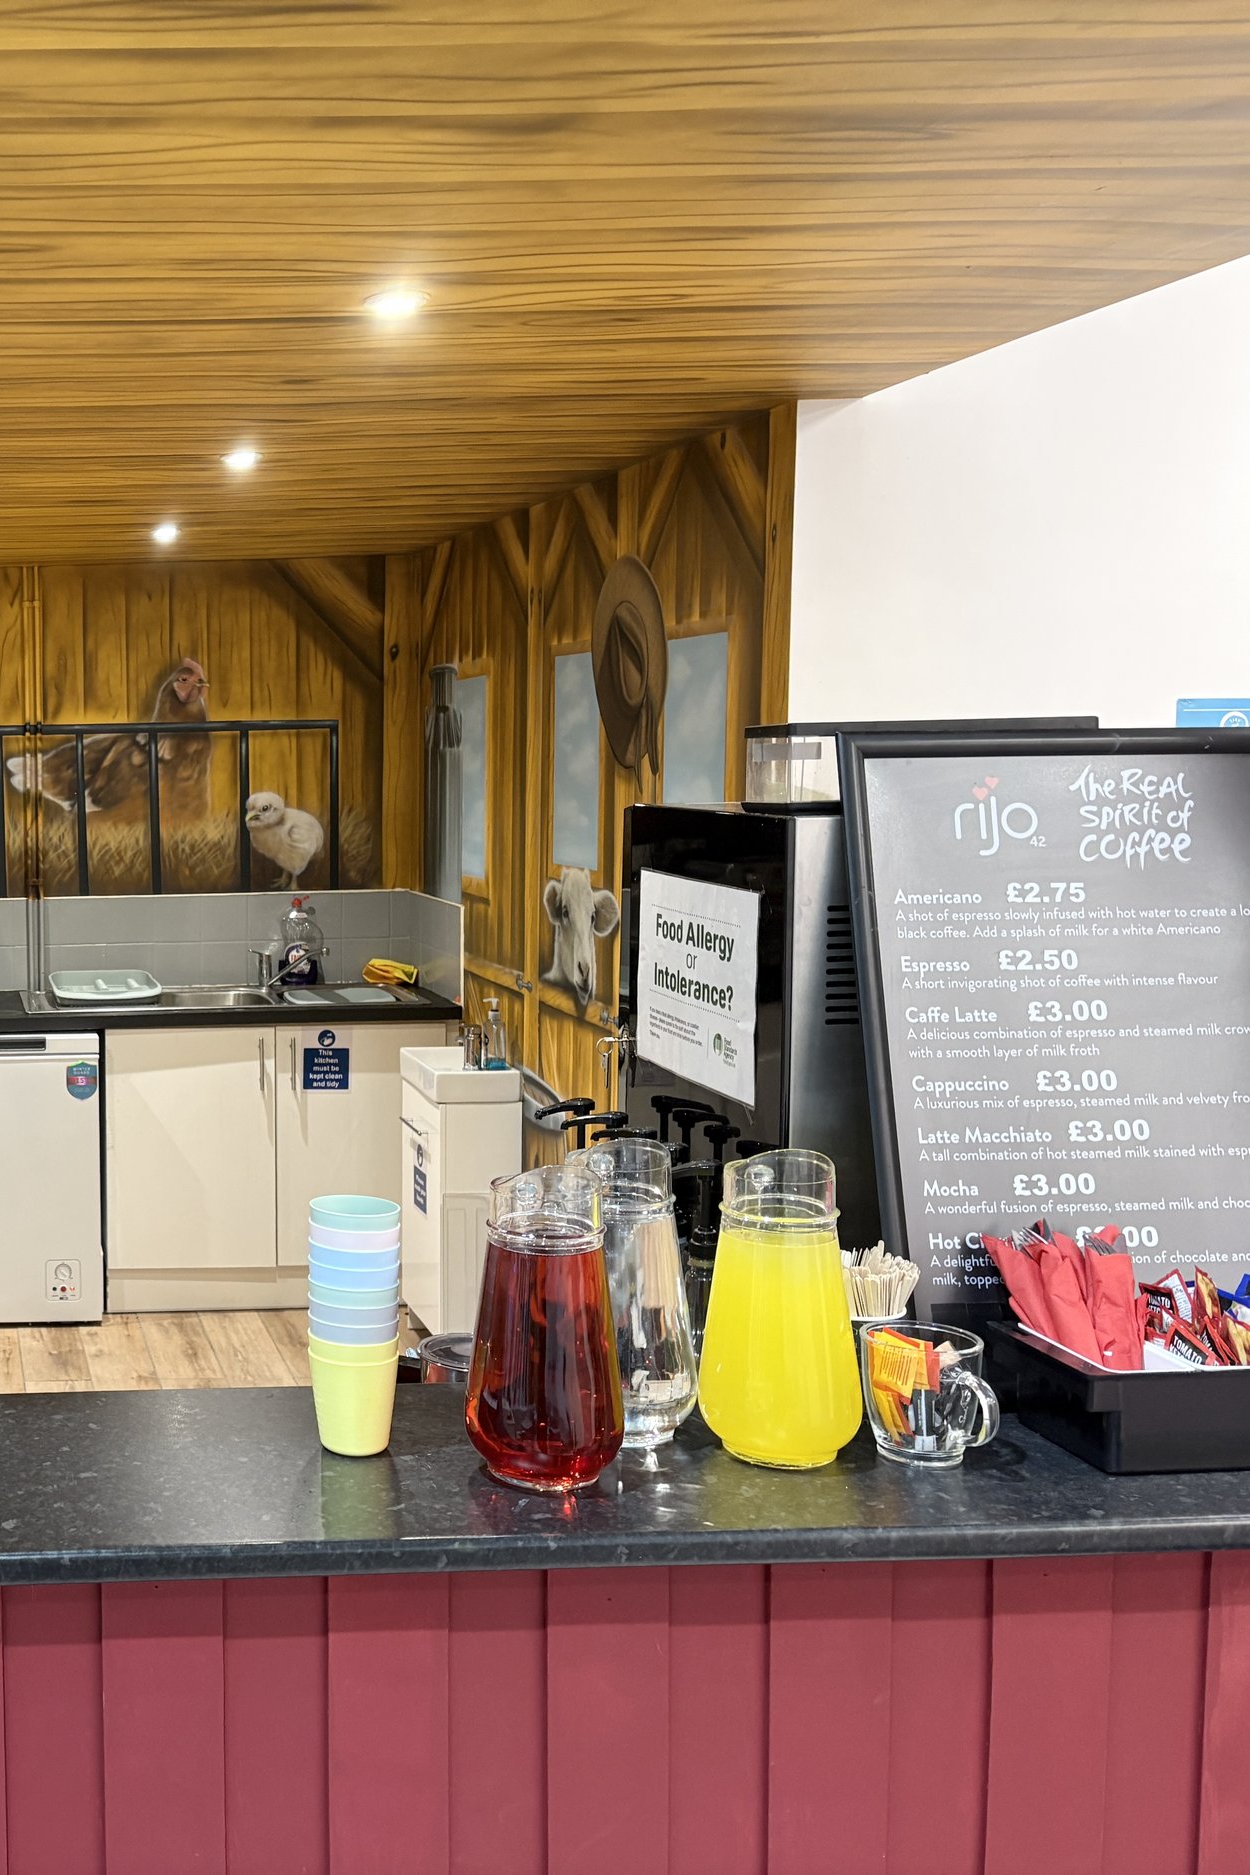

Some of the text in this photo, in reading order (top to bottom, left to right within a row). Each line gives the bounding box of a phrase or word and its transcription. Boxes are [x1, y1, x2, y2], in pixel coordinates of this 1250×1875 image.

[1068, 764, 1193, 803] The REAL
[954, 795, 1047, 856] rijo 42
[1167, 800, 1194, 830] of
[894, 882, 1086, 904] Americano £2.75
[909, 906, 1227, 925] shot espresso slowly infused with hot water create
[656, 913, 734, 962] Food Allergy
[897, 922, 1221, 941] black coffee. Add splash milk for white Americano
[686, 953, 698, 970] or
[901, 949, 1079, 977] Espresso £2.50
[654, 962, 734, 1011] Intolerance?
[915, 972, 1218, 992] short invigorating shot coffee with intense flavour
[905, 1000, 1108, 1023] Caffe Latte £3.00
[920, 1023, 1222, 1042] delicious combination espresso and steamed milk
[909, 1043, 1100, 1061] with smooth layer milk froth
[912, 1069, 1117, 1098] Cappuccino £3.00
[927, 1091, 1229, 1111] luxurious mix espresso, steamed milk and velvety
[918, 1119, 1150, 1144] Latte Macchiato £3.00
[932, 1144, 1224, 1161] tall combination hot steamed milk stained with
[923, 1173, 1096, 1196] Mocha £3.00
[938, 1197, 1218, 1216] wonderful fusion espresso, steamed milk and
[929, 1233, 961, 1250] Hot
[944, 1250, 1229, 1272] delightfu chocolate
[933, 1272, 961, 1287] milk,
[1172, 1334, 1203, 1365] TOMATO
